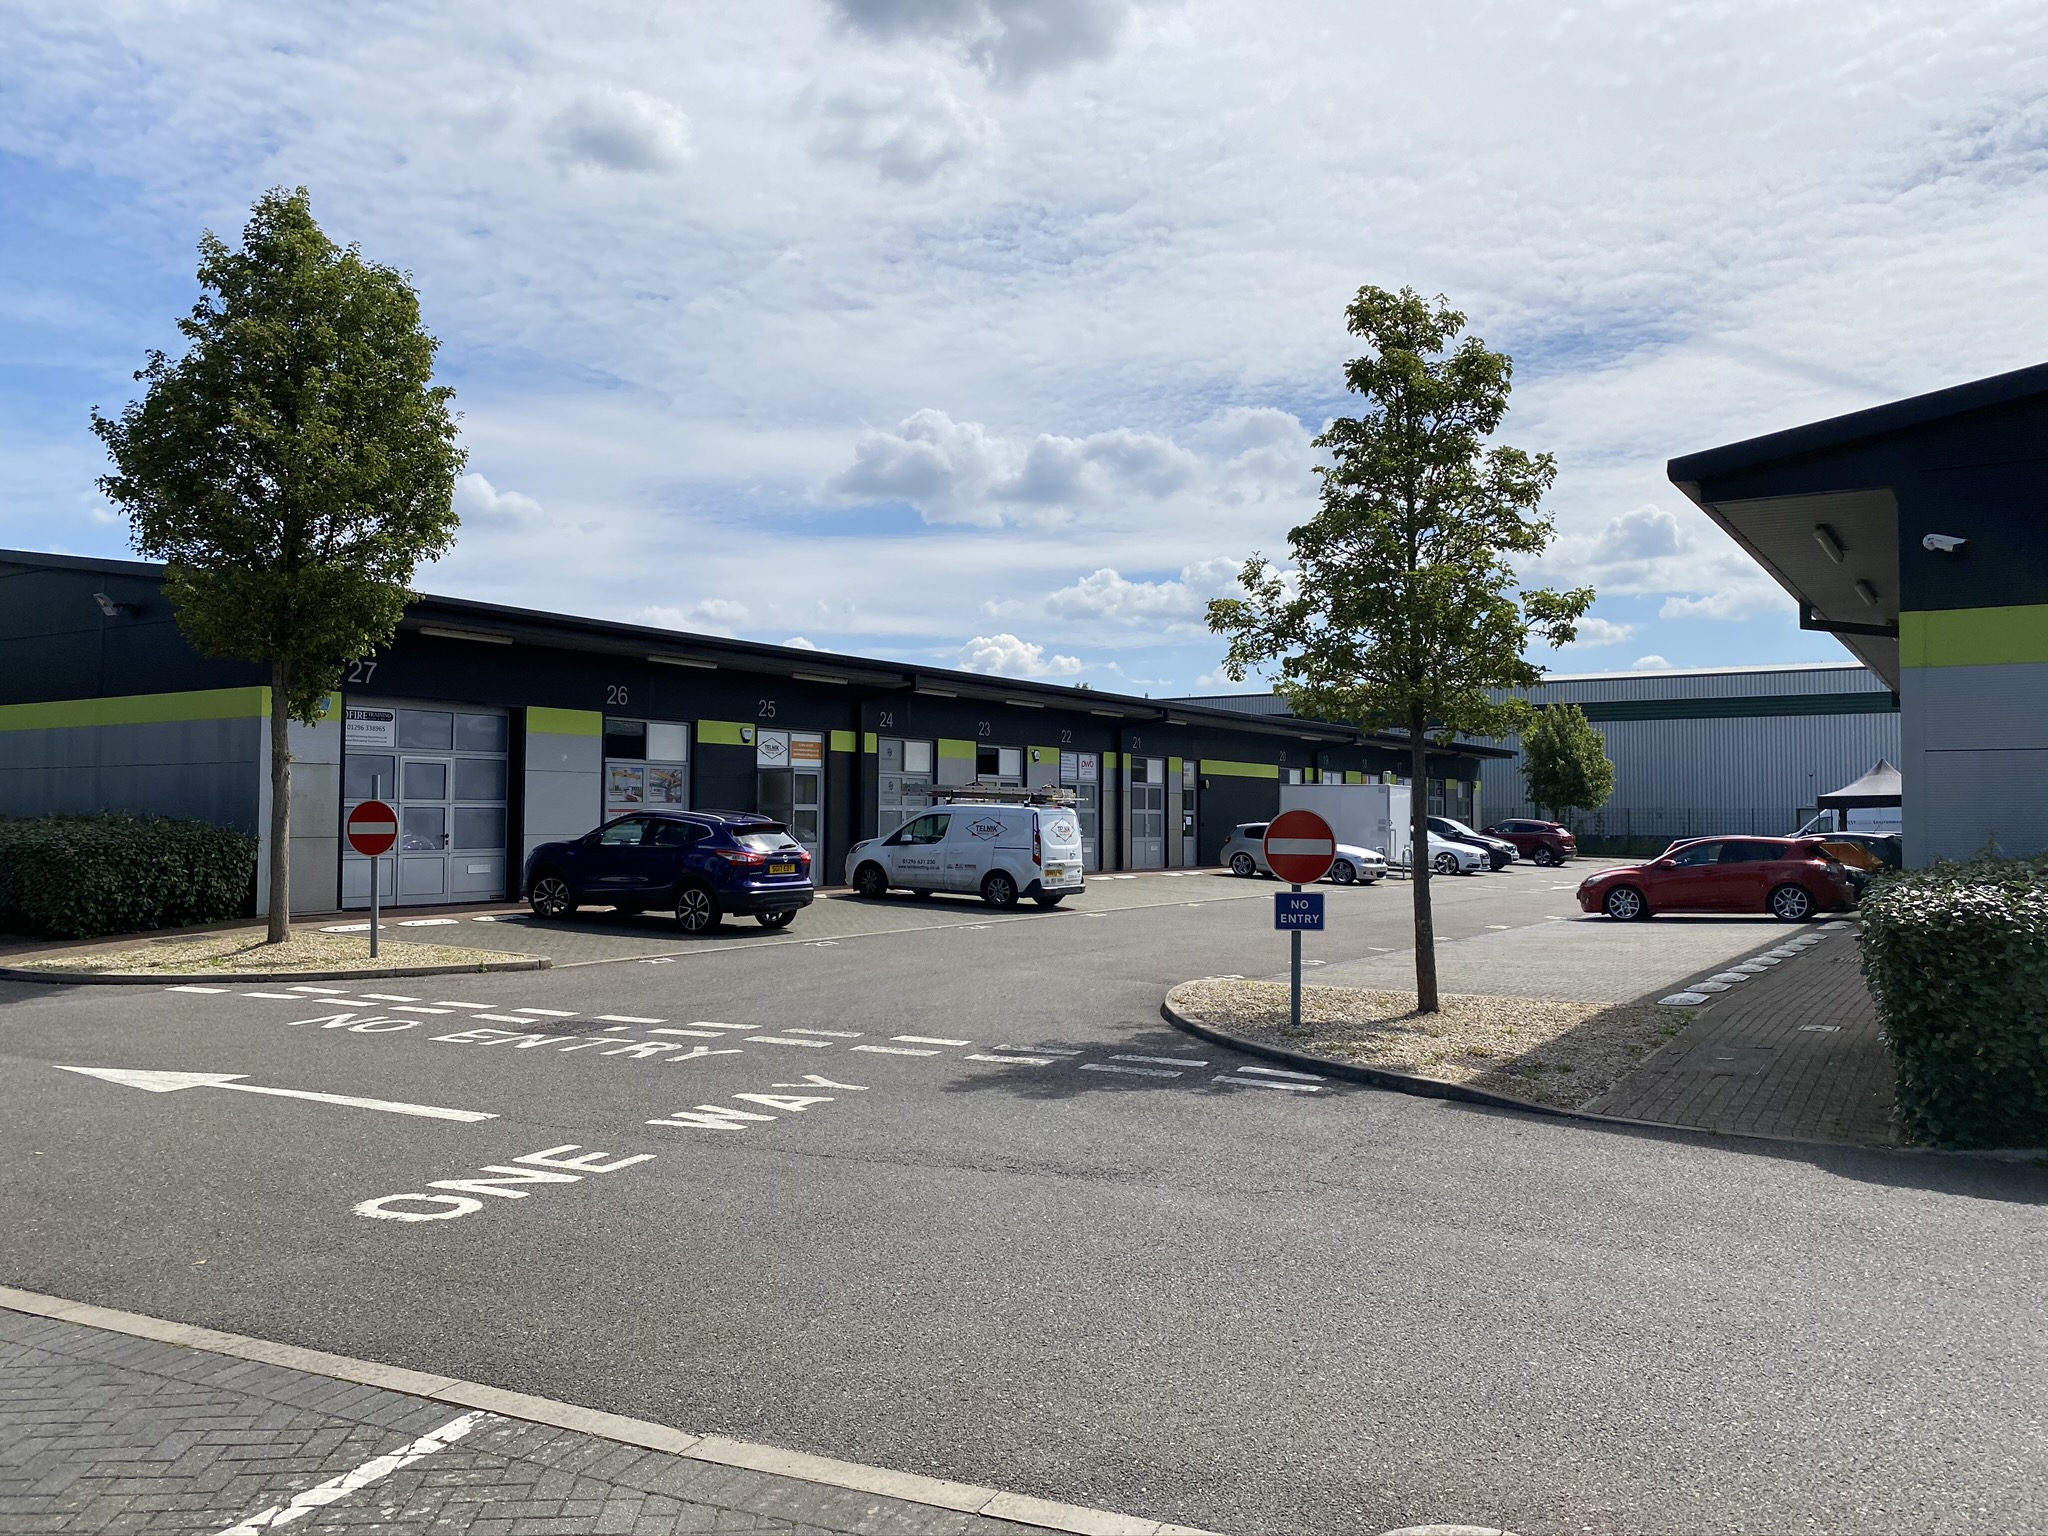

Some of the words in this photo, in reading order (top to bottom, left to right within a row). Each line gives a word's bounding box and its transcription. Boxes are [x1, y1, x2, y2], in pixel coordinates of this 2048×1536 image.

[347, 660, 378, 684] 27
[606, 685, 629, 705] 26
[758, 700, 776, 718] 25
[879, 711, 894, 728] 24
[978, 721, 991, 737] 23
[1061, 729, 1072, 744] 22
[1132, 736, 1141, 749] 21
[1279, 751, 1287, 762] 20
[975, 824, 999, 833] TELNIK
[1290, 899, 1309, 910] NO
[1280, 913, 1320, 924] ENTRY
[286, 1012, 423, 1033] NO
[428, 1027, 744, 1062] ENTRY
[350, 1143, 658, 1222] ONE
[644, 1074, 870, 1131] WAY
